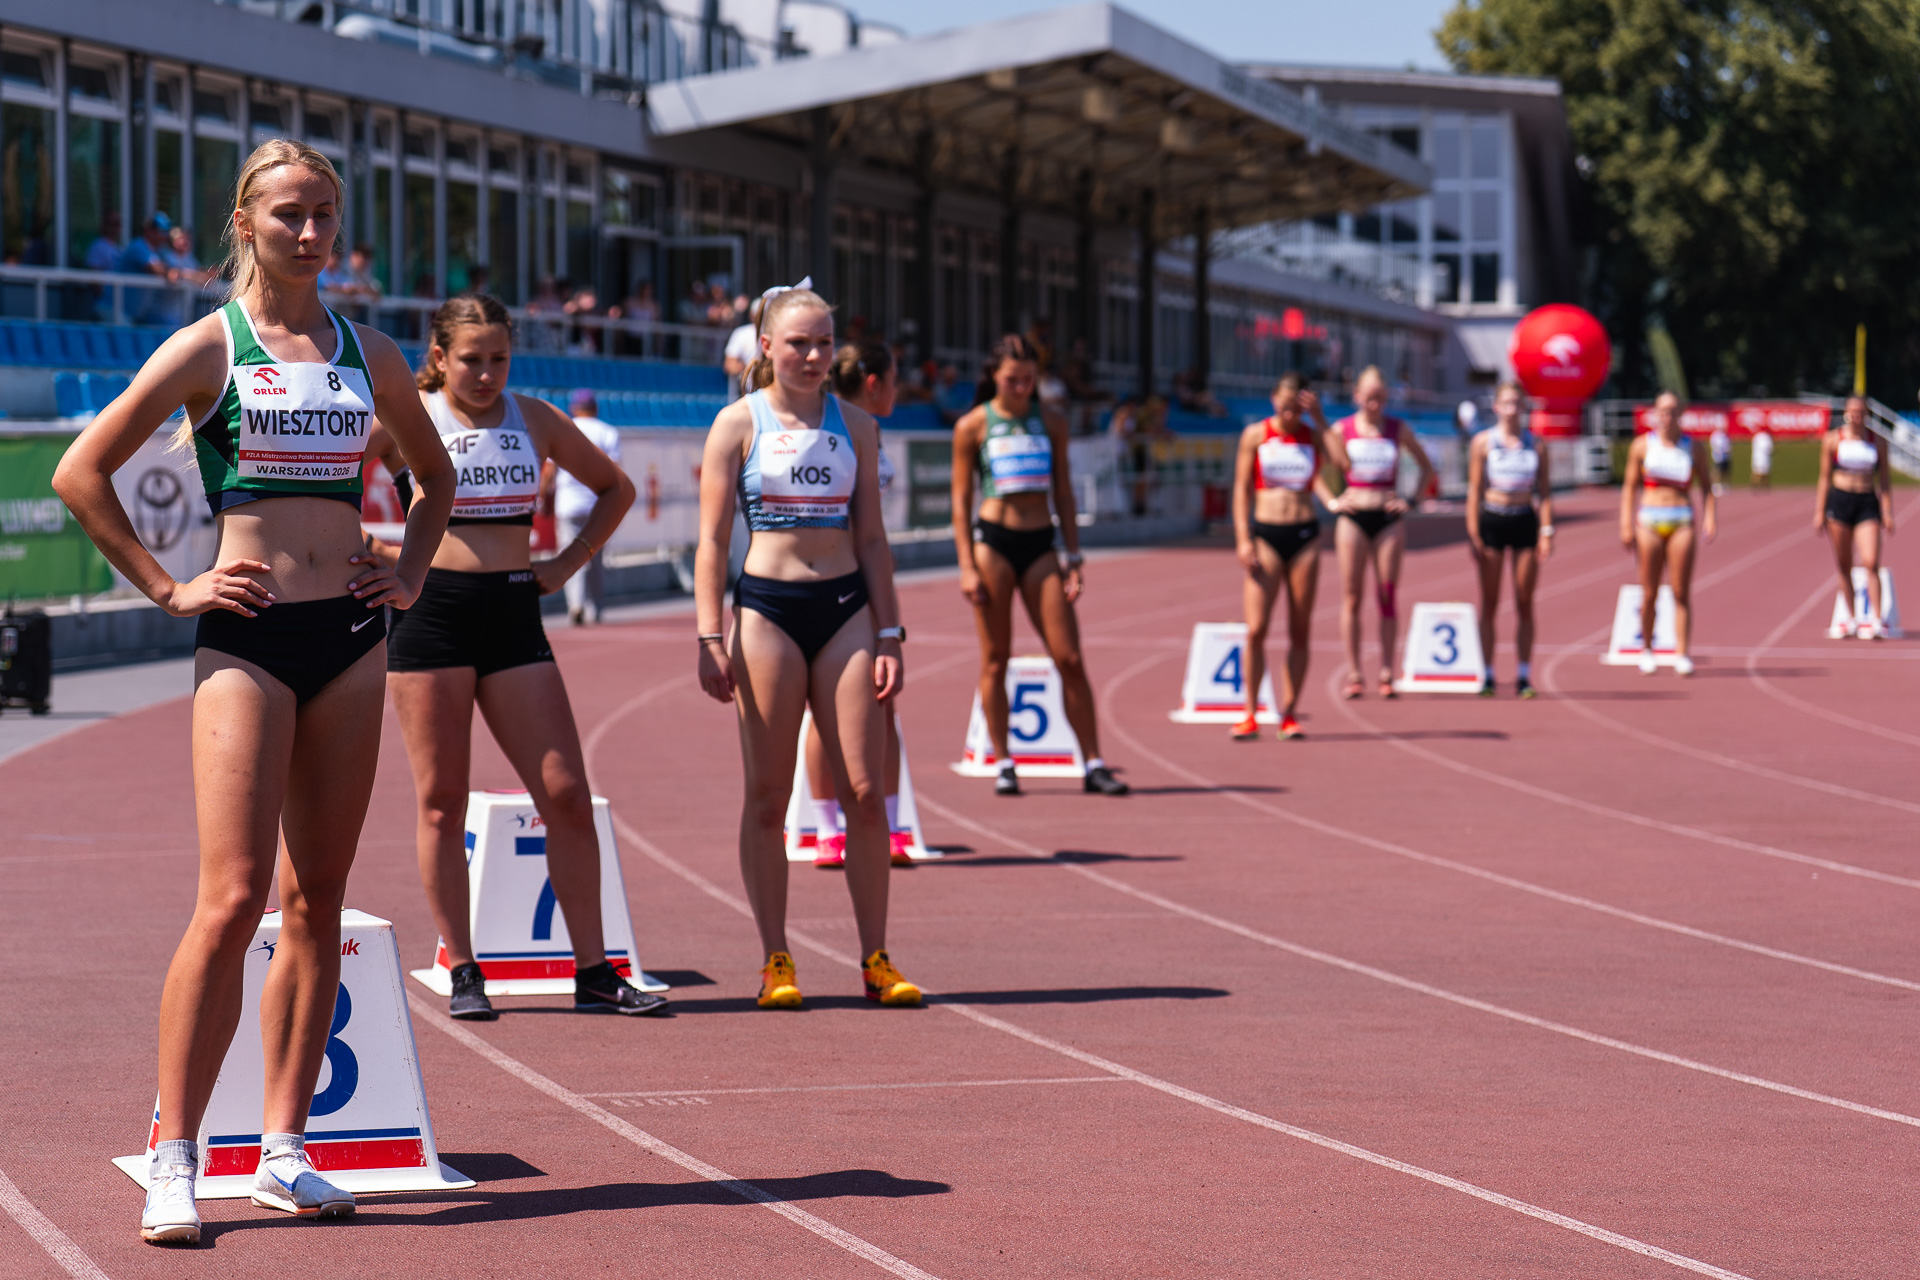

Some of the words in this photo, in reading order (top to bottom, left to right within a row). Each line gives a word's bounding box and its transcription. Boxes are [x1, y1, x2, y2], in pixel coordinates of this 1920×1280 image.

[326, 371, 341, 392] 8
[253, 387, 287, 395] ORLEN
[247, 409, 369, 437] WIESZTORT
[499, 434, 521, 450] 32
[827, 435, 838, 453] 9
[256, 465, 331, 477] WARSZAWA
[331, 466, 350, 477] 2026
[455, 465, 535, 486] ABRYCH
[791, 466, 832, 485] KOS
[453, 505, 507, 515] WARSZAWA
[773, 505, 825, 514] WARSZAWA
[508, 572, 528, 583] NIKE
[1433, 622, 1459, 667] 3
[1212, 645, 1243, 694] 4
[1009, 683, 1049, 742] 5
